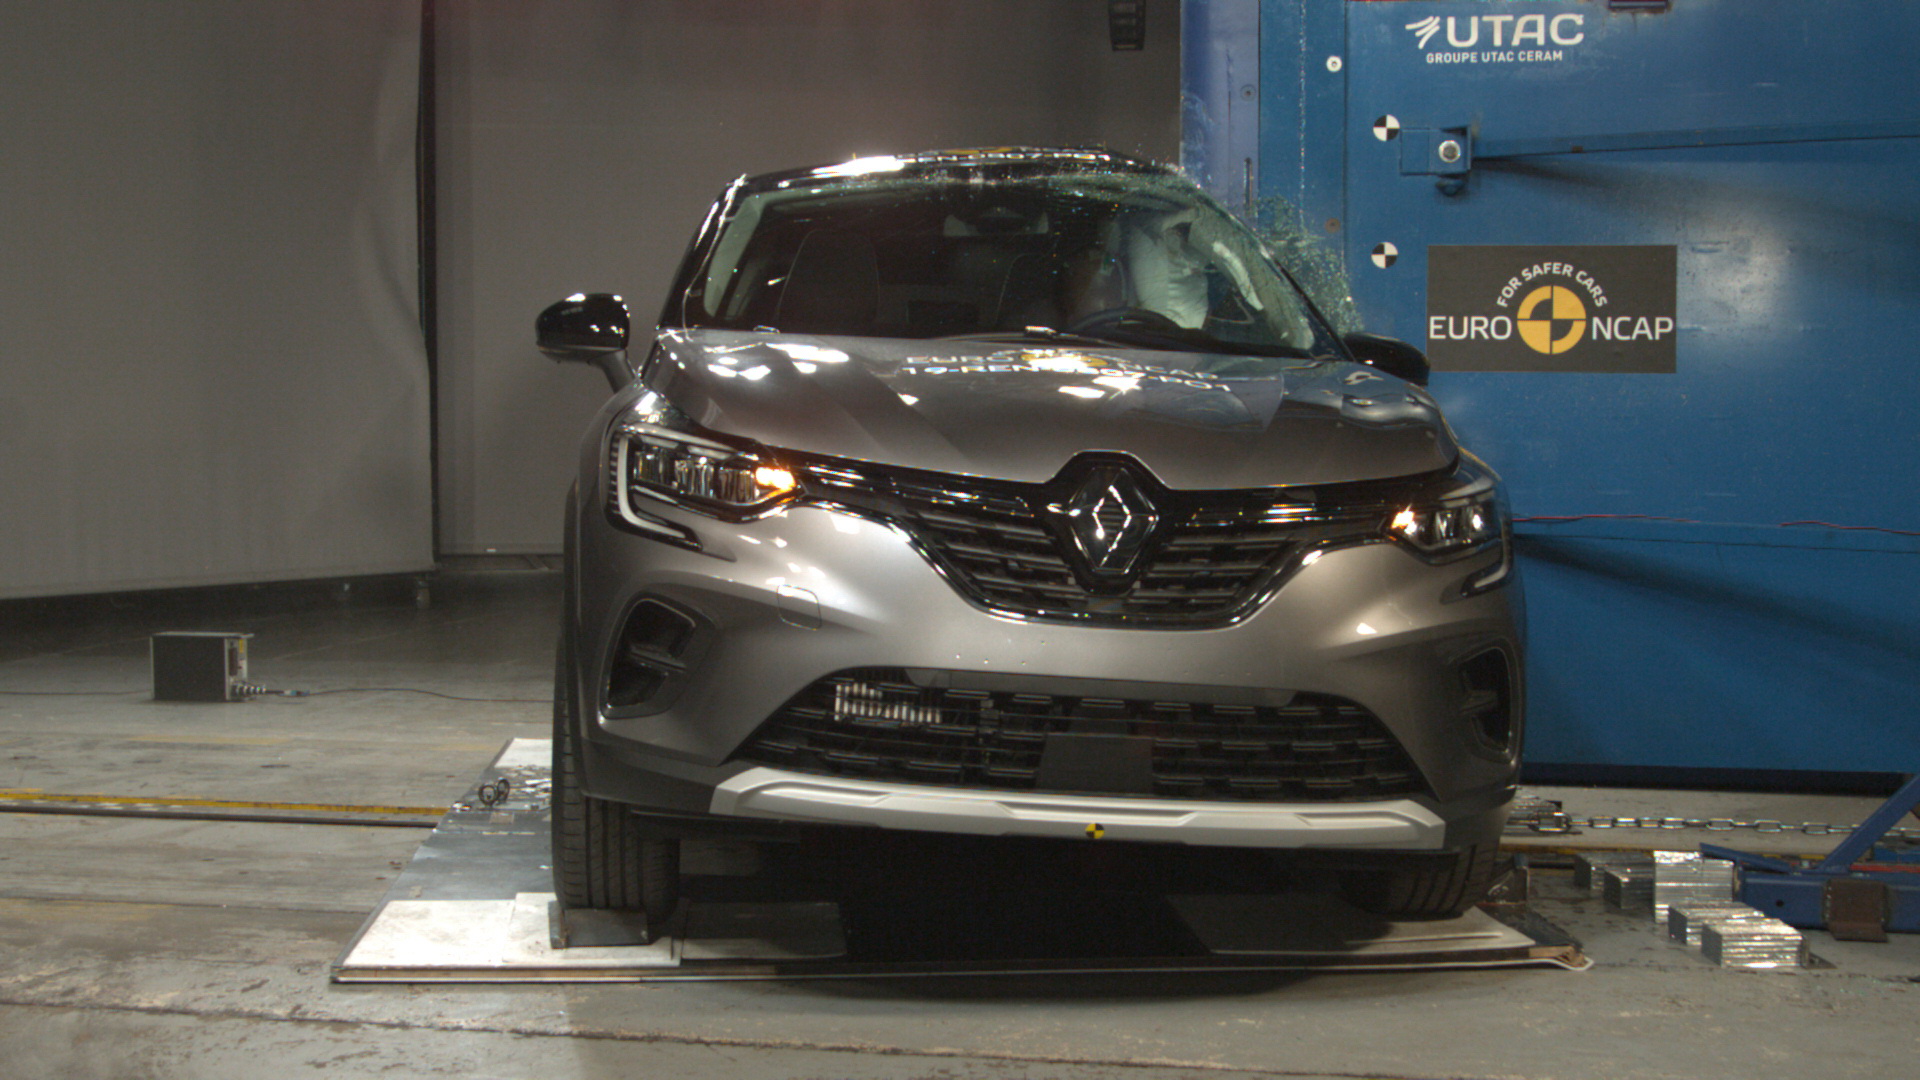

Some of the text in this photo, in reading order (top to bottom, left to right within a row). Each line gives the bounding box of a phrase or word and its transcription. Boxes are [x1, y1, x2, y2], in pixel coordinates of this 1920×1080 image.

[1447, 13, 1584, 48] UTAC
[1426, 50, 1563, 64] GROUPE UTAC CERAM
[1496, 262, 1608, 308] FOR SAFER CARS
[1429, 315, 1674, 341] EURO NCAP
